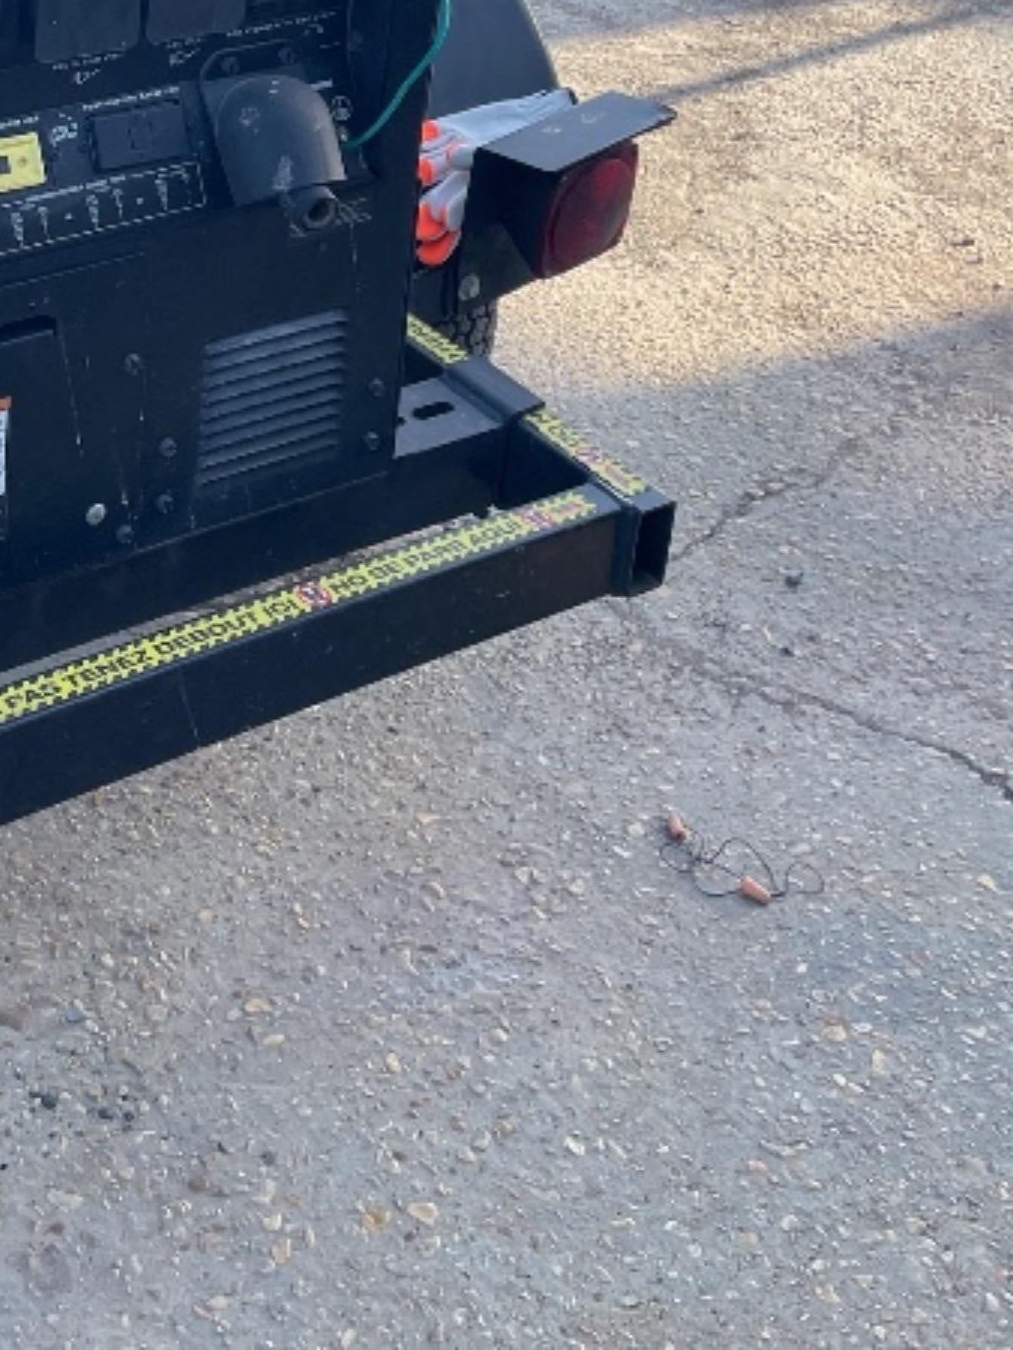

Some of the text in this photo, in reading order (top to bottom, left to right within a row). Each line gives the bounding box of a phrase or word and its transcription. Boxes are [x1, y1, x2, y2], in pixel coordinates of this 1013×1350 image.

[329, 574, 368, 594] NO
[4, 682, 61, 710] PAS
[59, 646, 155, 689] TENEZ
[153, 610, 258, 654] DEBOUT
